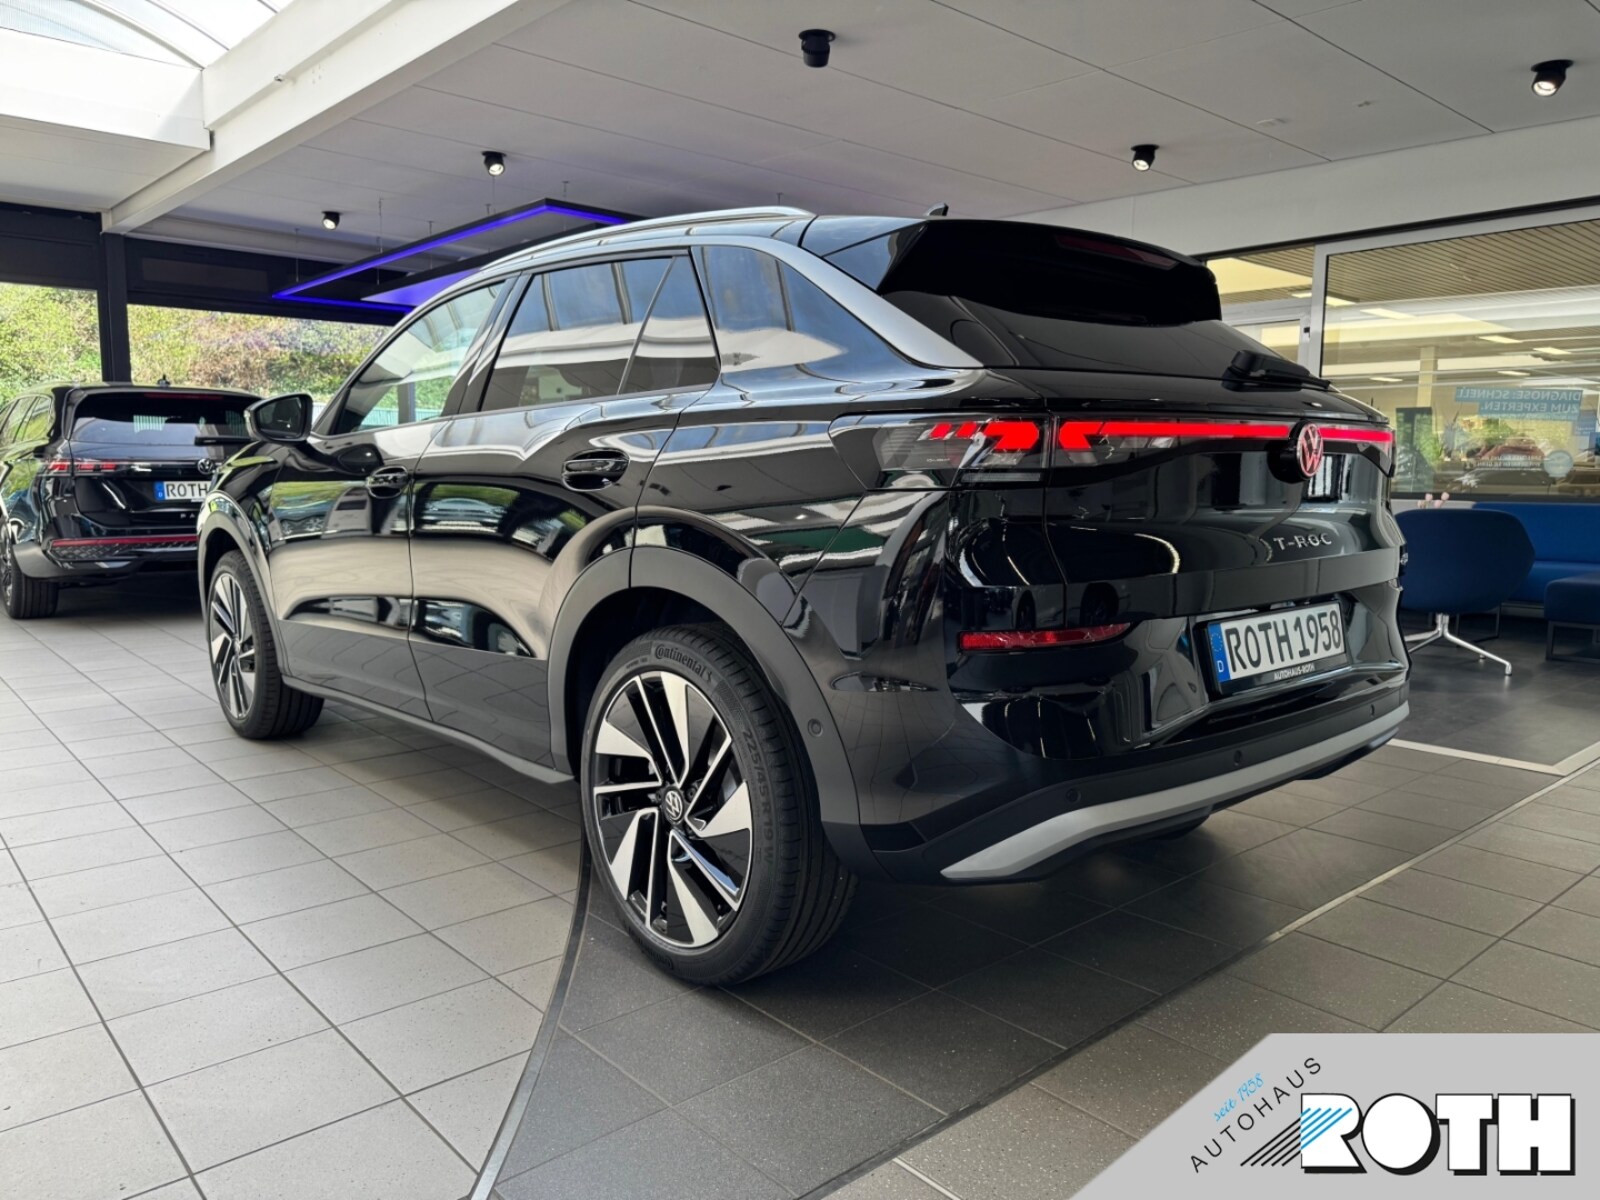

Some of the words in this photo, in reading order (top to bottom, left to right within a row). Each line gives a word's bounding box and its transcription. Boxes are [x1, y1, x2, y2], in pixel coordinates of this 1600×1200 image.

[1273, 532, 1332, 551] T-ROC
[654, 643, 708, 679] Continental
[1216, 660, 1225, 673] D
[742, 728, 771, 797] 225/45
